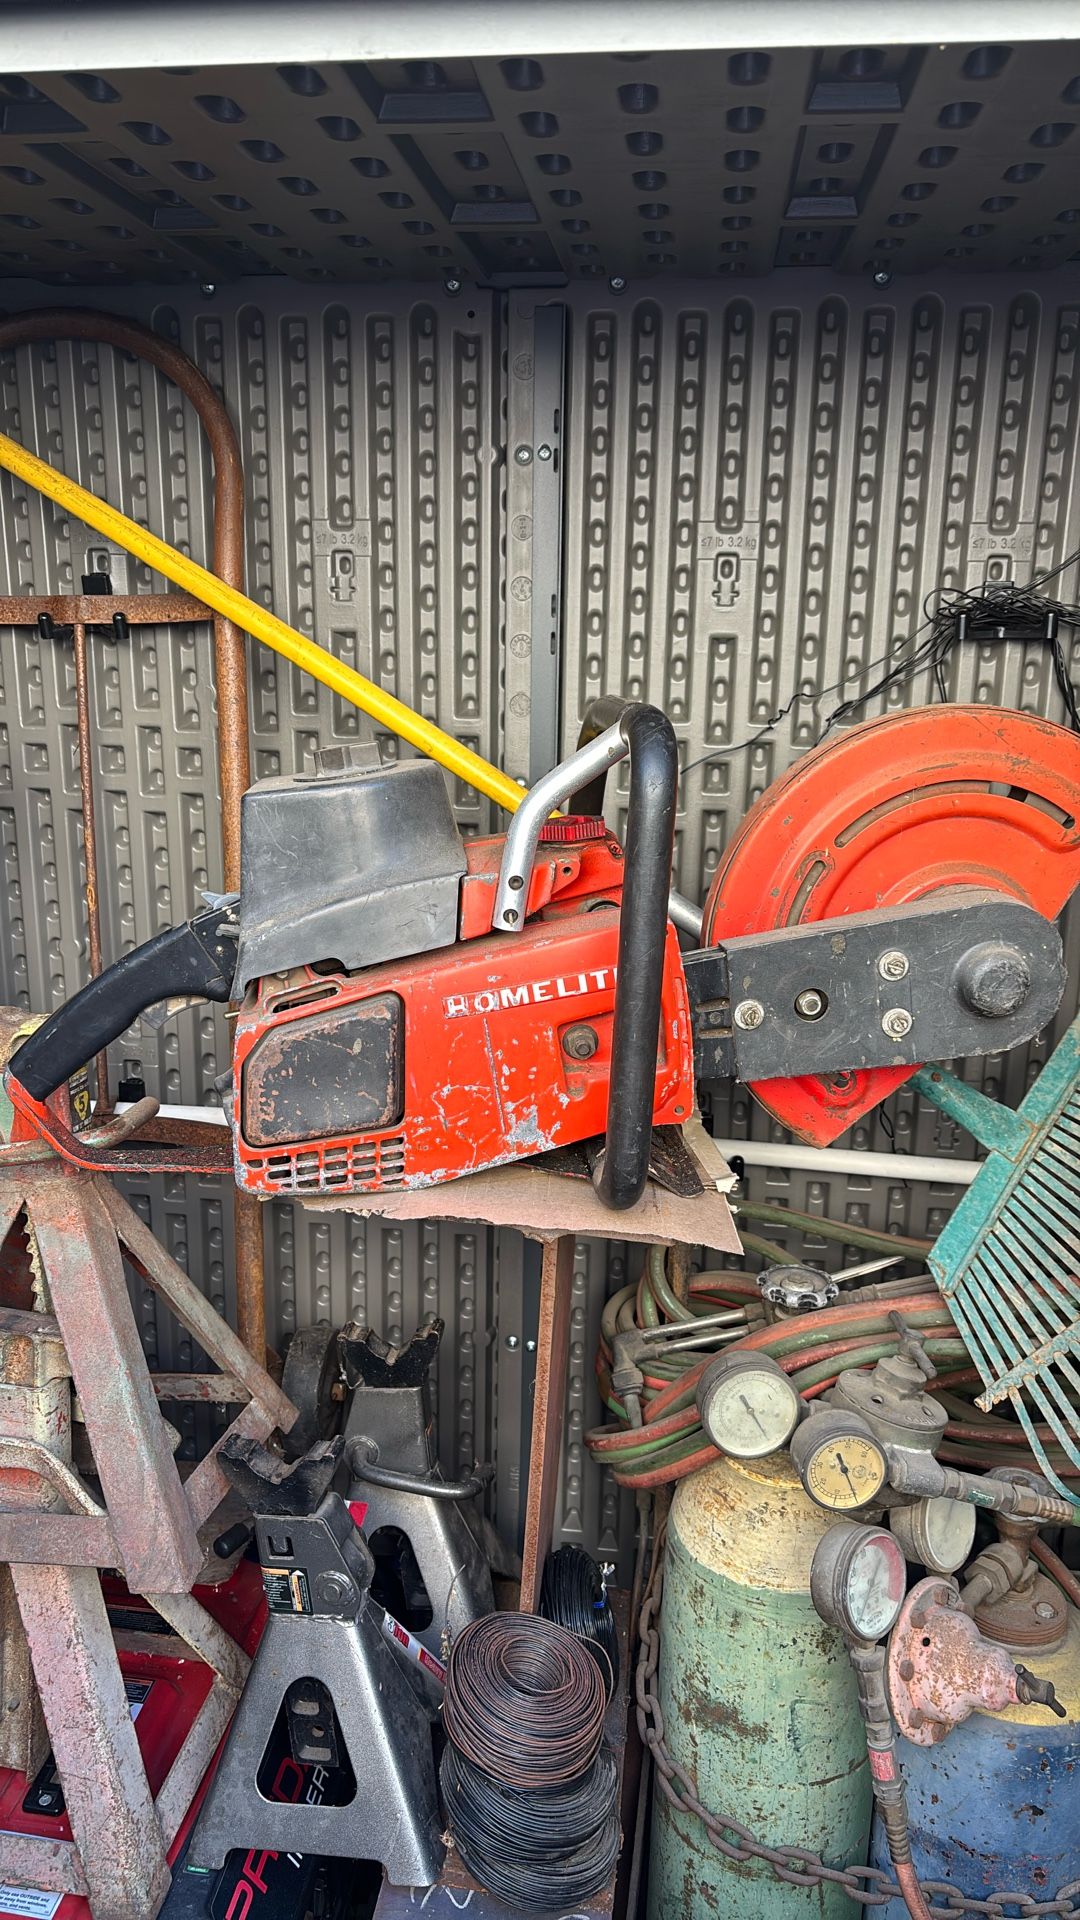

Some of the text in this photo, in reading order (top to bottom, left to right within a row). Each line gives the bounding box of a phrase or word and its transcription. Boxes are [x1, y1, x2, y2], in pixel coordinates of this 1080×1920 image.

[340, 533, 355, 545] 3.2
[715, 536, 724, 548] lb
[728, 536, 742, 548] 3.2
[745, 536, 757, 550] kg
[987, 537, 997, 549] lb
[1000, 537, 1016, 549] 3.2
[446, 967, 617, 1018] HOMELIT
